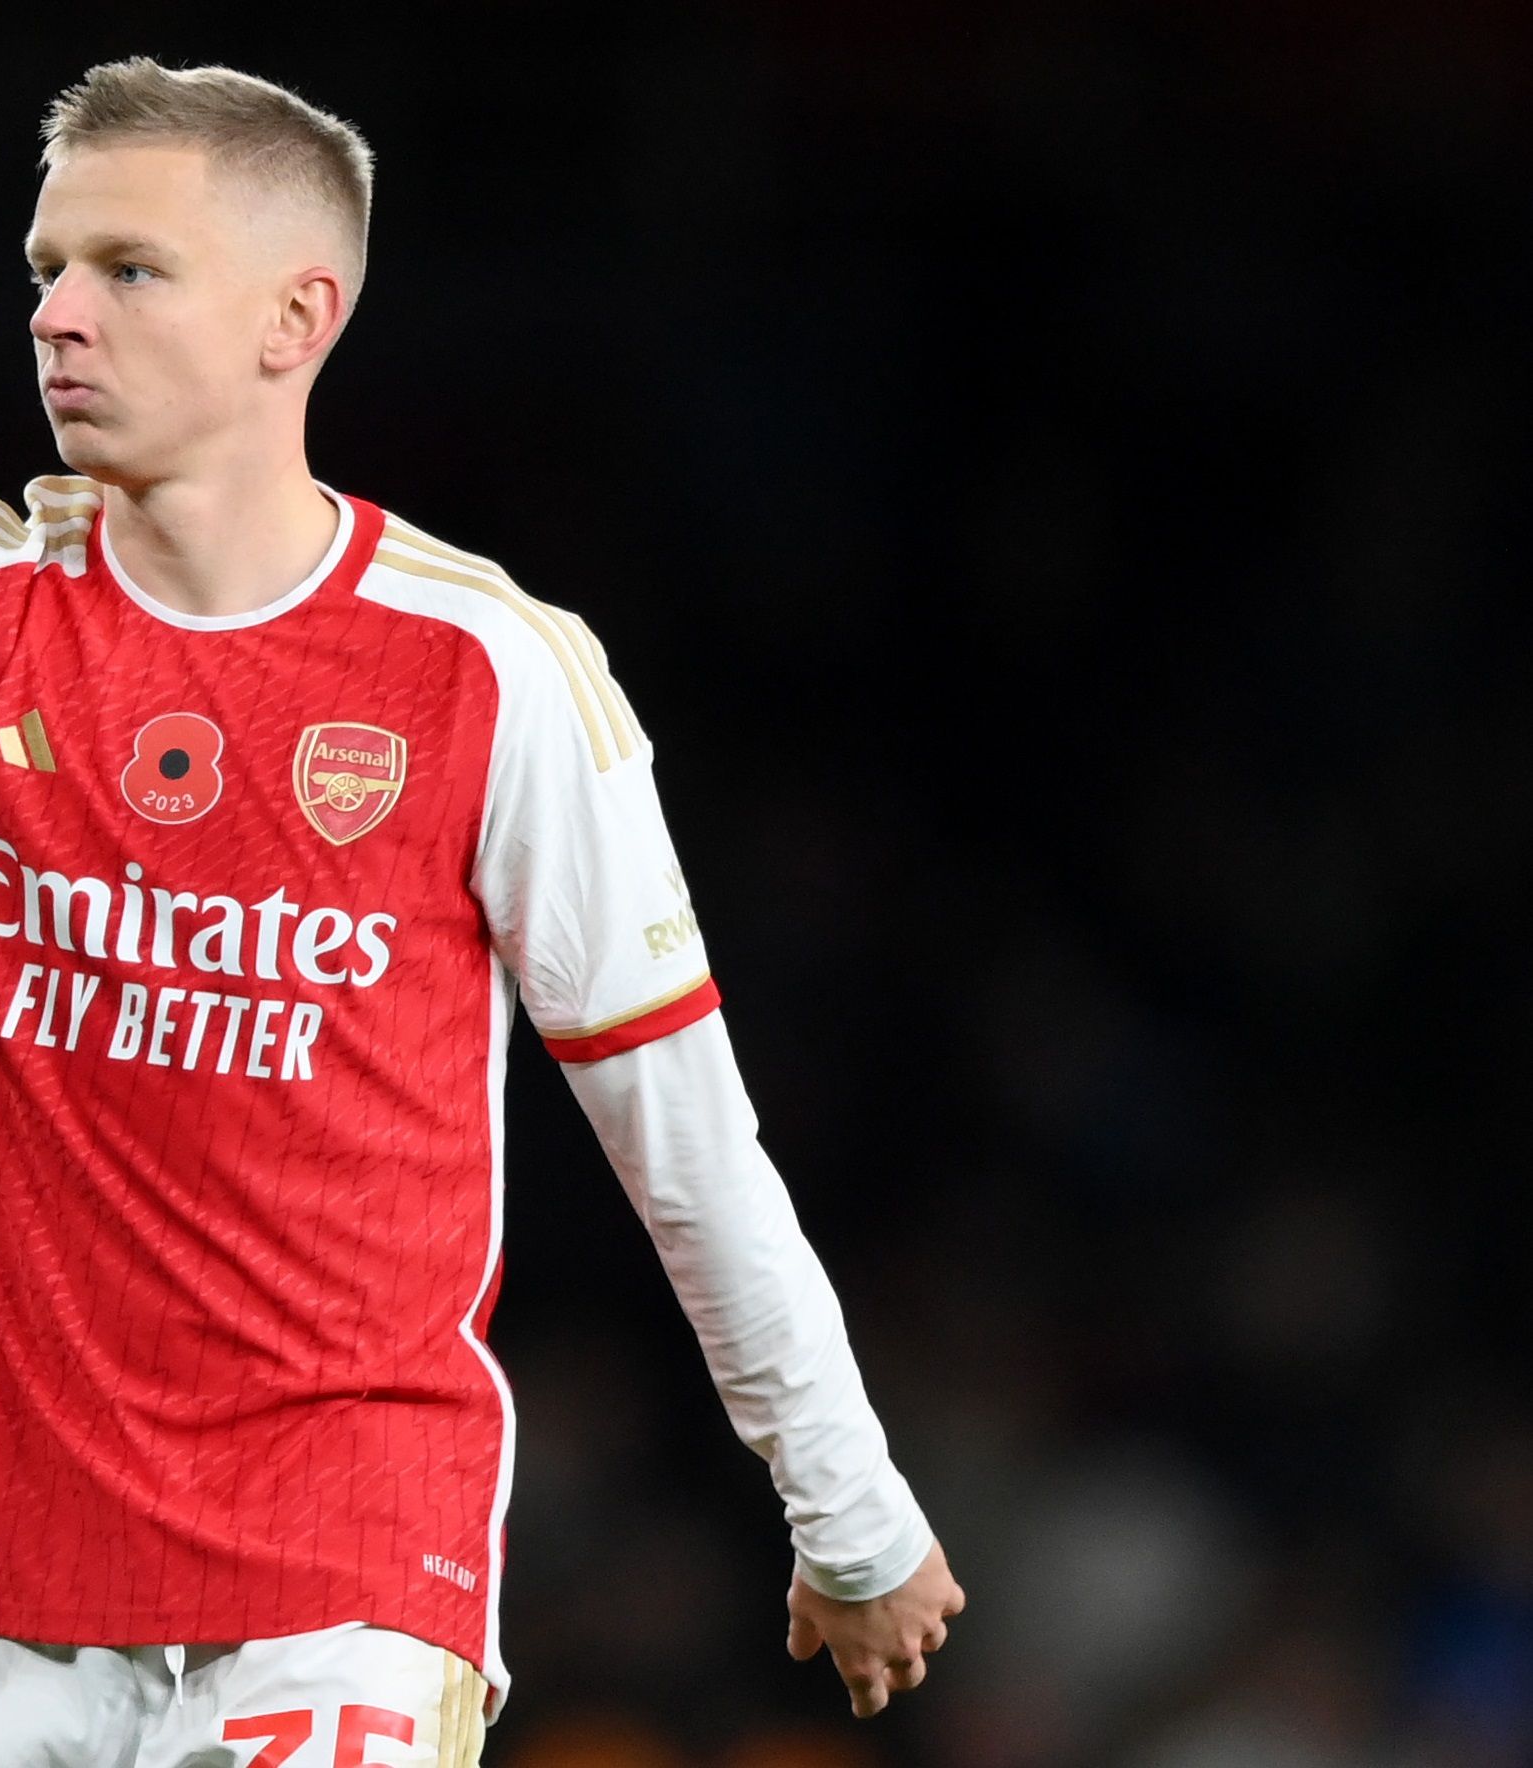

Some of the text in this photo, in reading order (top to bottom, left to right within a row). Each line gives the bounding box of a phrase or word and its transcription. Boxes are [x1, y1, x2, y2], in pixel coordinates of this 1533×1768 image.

[313, 742, 392, 769] Arsenal
[141, 789, 195, 813] 2023
[0, 963, 324, 1081] FLY BETTER
